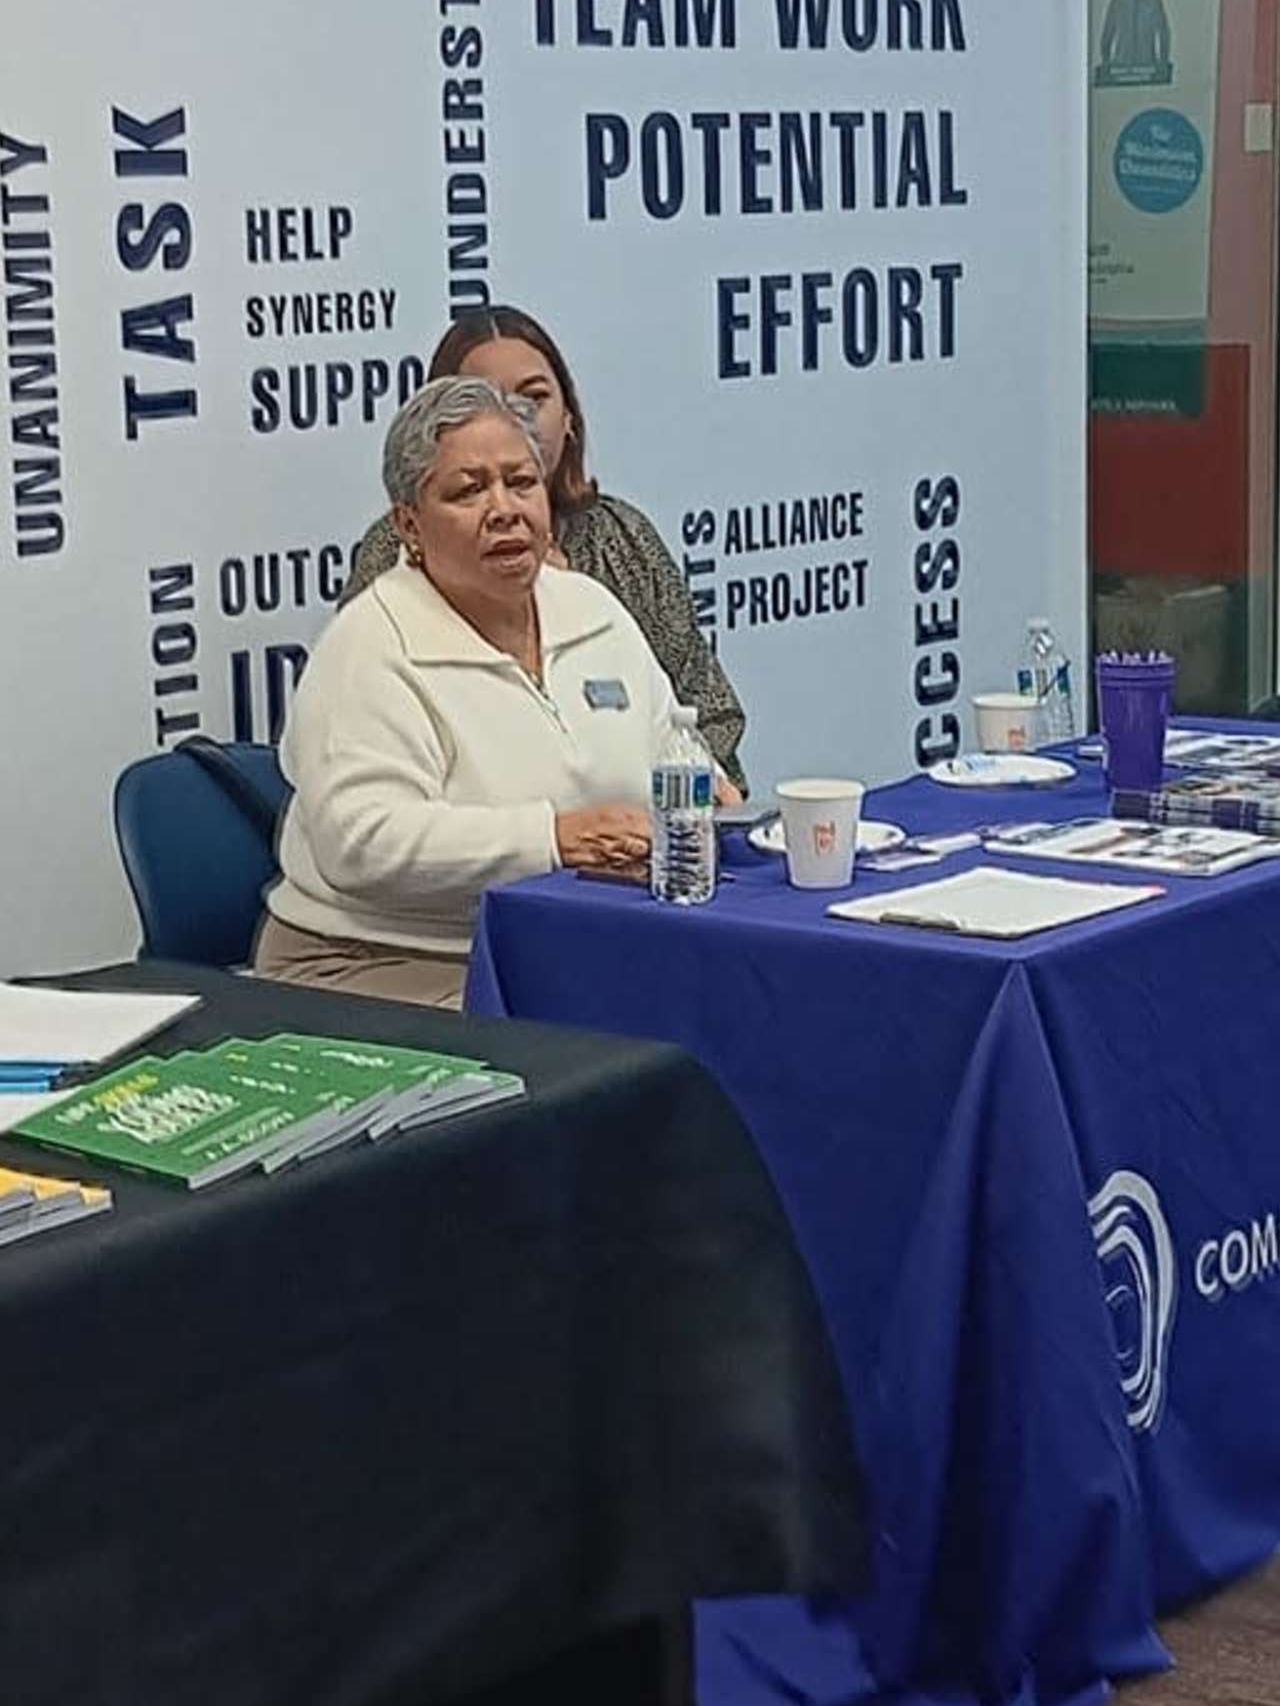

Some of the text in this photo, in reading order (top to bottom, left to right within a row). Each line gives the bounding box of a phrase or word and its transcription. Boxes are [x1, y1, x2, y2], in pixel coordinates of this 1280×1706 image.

[586, 109, 968, 221] POTENTIAL
[246, 205, 353, 263] HELP
[111, 105, 197, 441] TASK
[246, 289, 398, 338] SYNERGY
[718, 262, 964, 380] EFFORT
[724, 492, 864, 555] ALLIANCE
[727, 559, 869, 630] PROJECT
